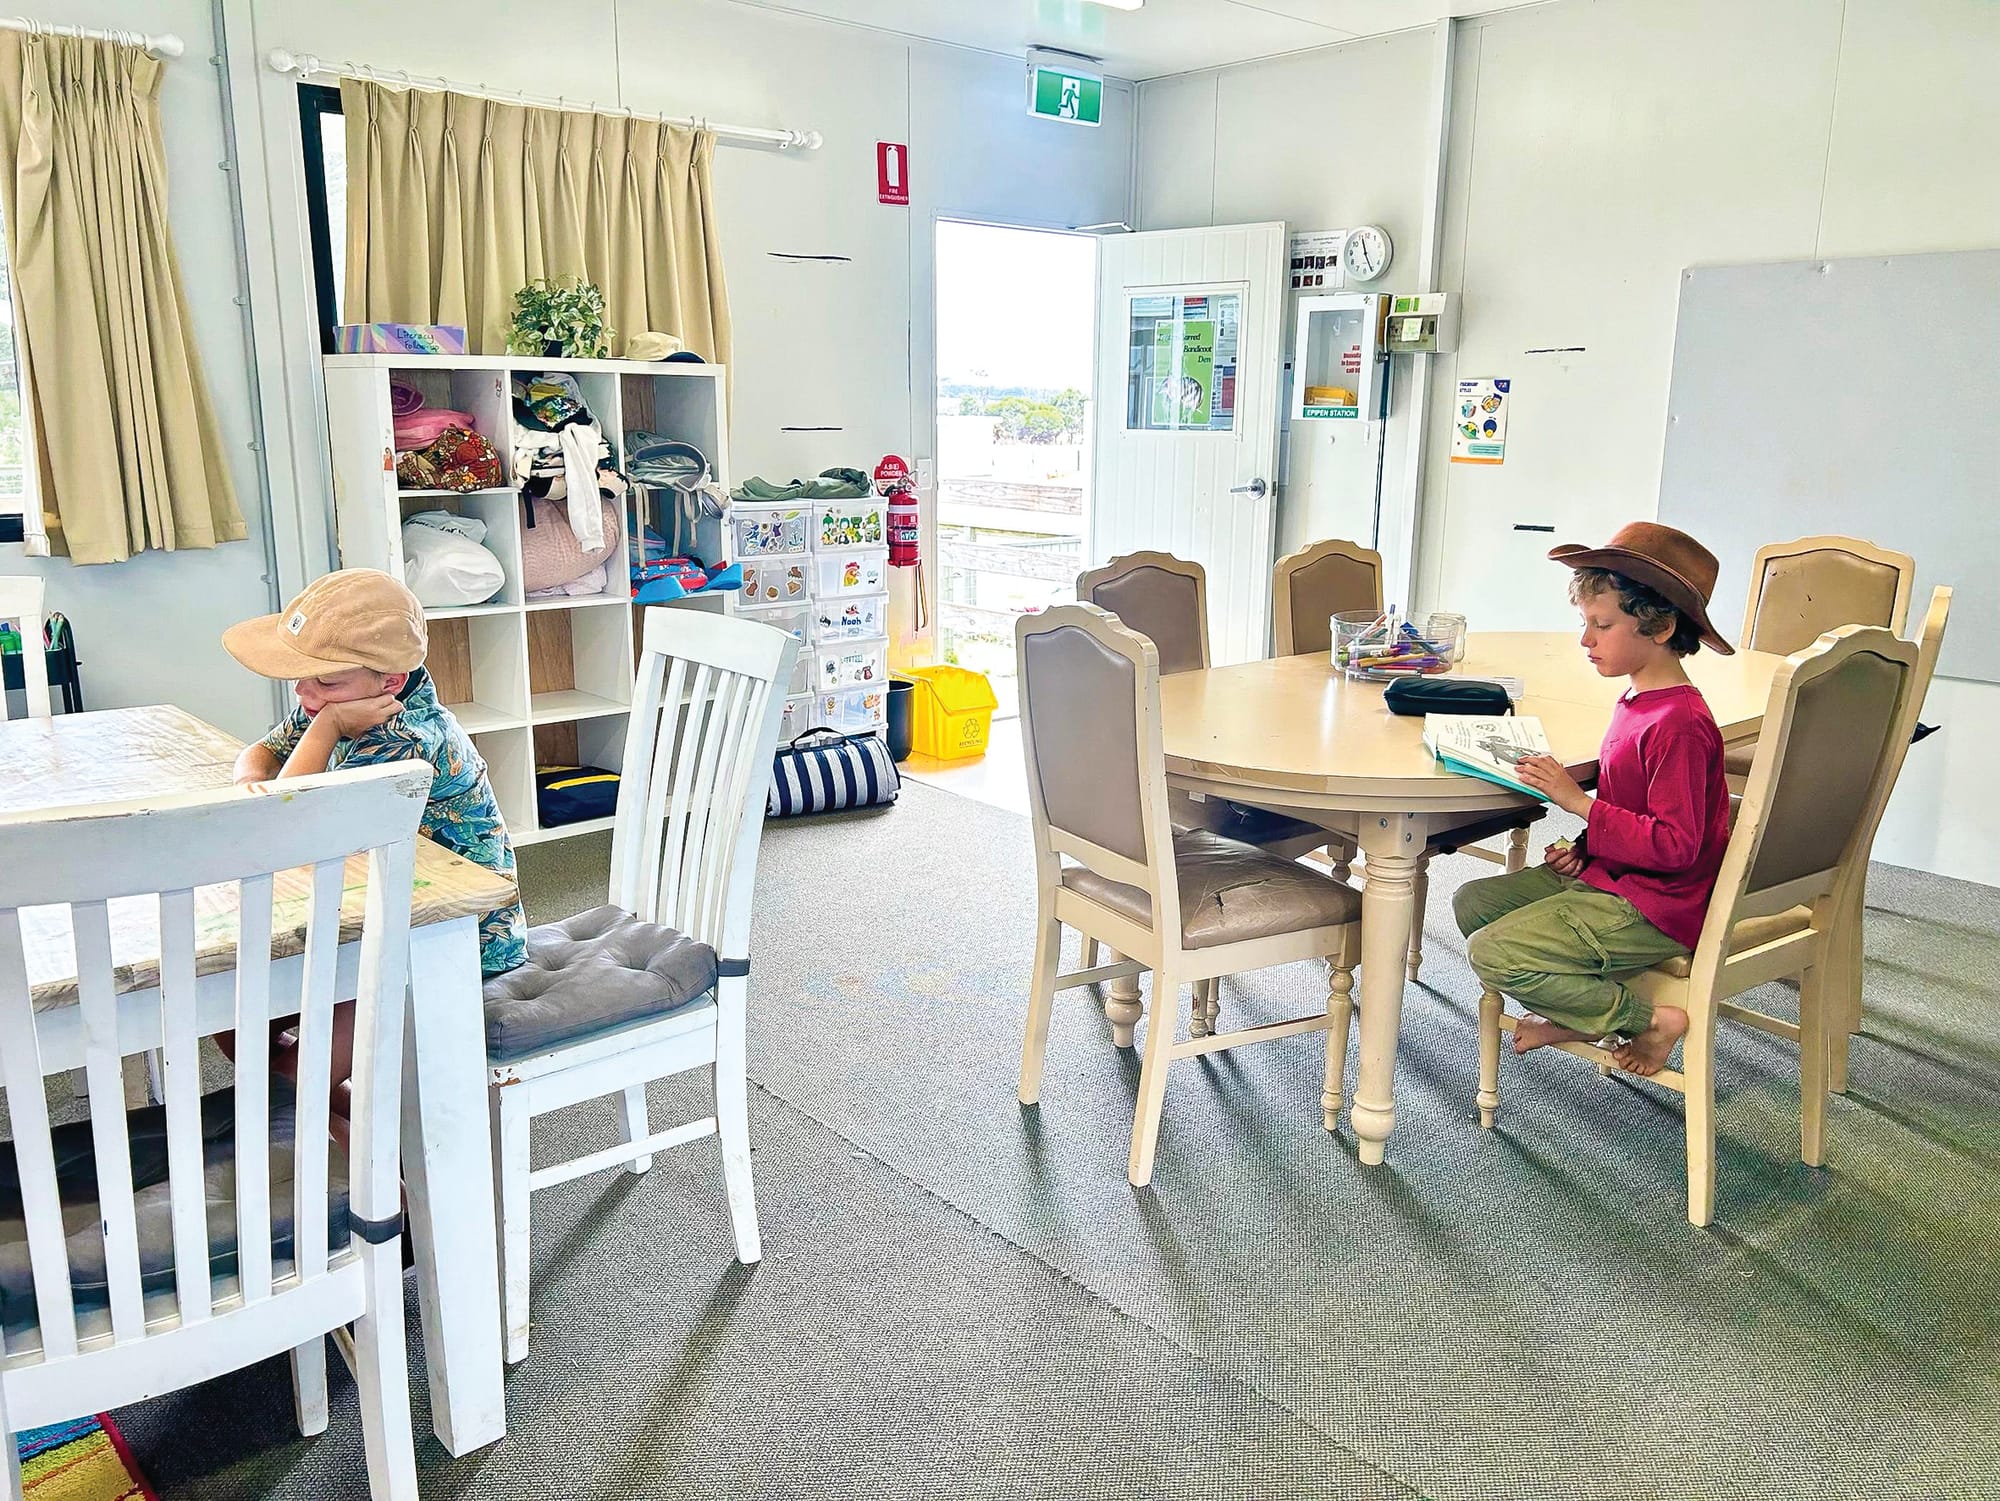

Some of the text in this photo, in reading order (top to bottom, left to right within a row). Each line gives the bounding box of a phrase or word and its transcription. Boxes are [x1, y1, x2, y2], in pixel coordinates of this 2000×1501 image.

[397, 328, 434, 344] Literacy
[1184, 344, 1212, 353] Bandicoot
[1307, 409, 1329, 417] EPIPEN
[880, 469, 903, 478] POWDER
